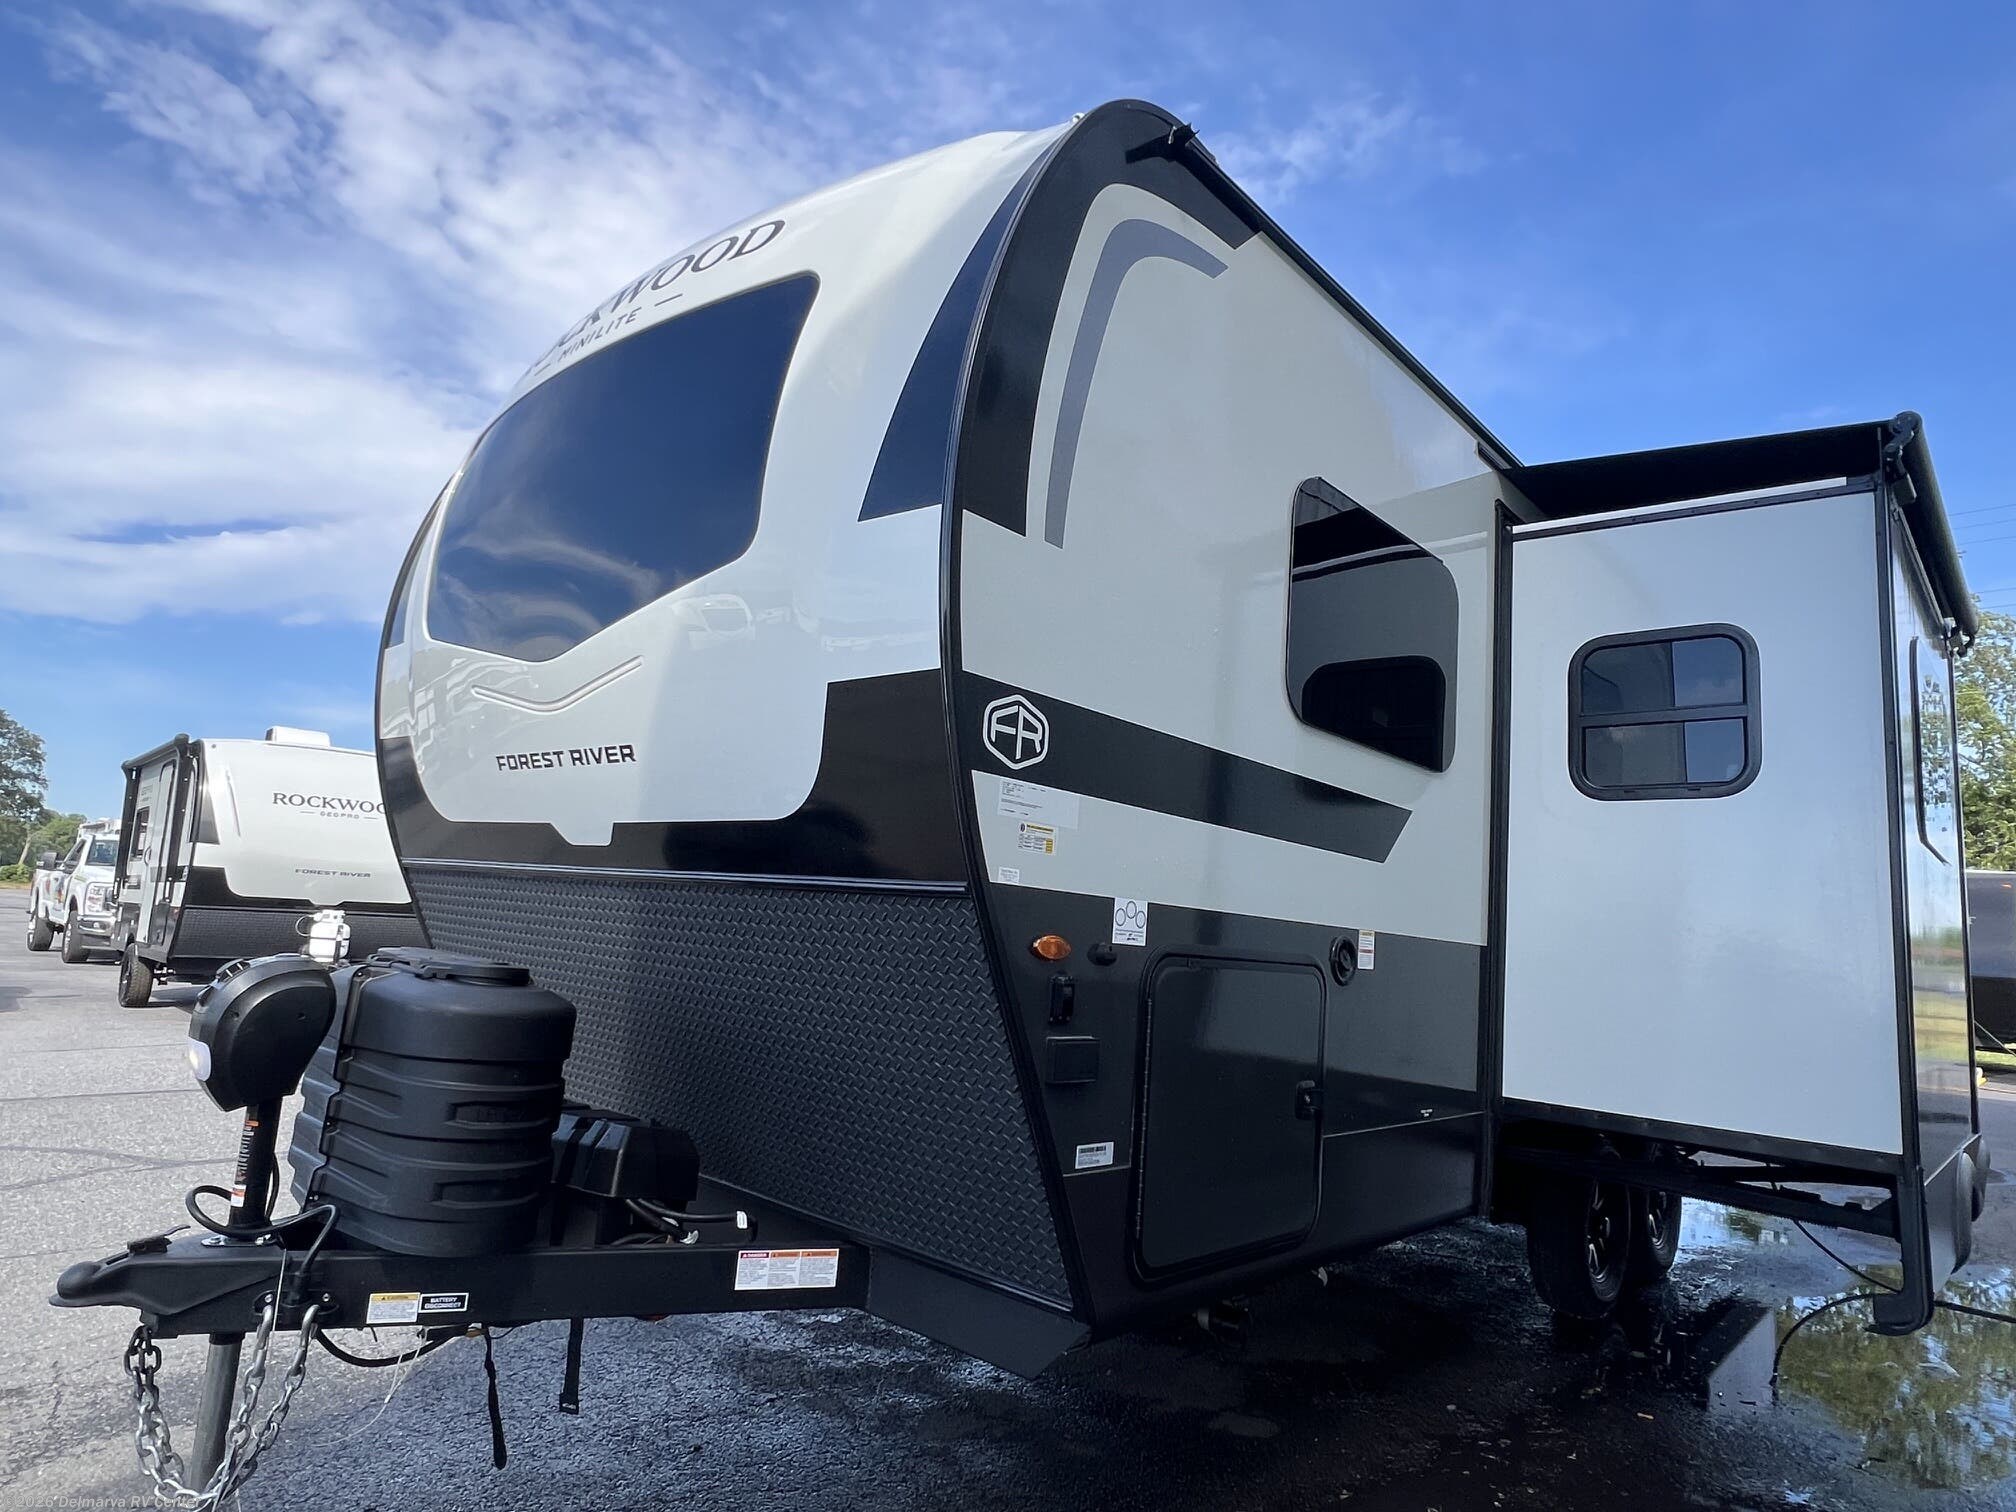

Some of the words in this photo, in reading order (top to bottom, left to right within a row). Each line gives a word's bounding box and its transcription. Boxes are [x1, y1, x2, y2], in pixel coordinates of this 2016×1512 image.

[526, 220, 786, 374] KWOOD
[557, 306, 642, 362] MINILITE
[495, 750, 564, 771] FOREST
[568, 744, 637, 767] RIVER
[272, 792, 386, 815] ROCKWOO
[295, 868, 337, 877] FOREST
